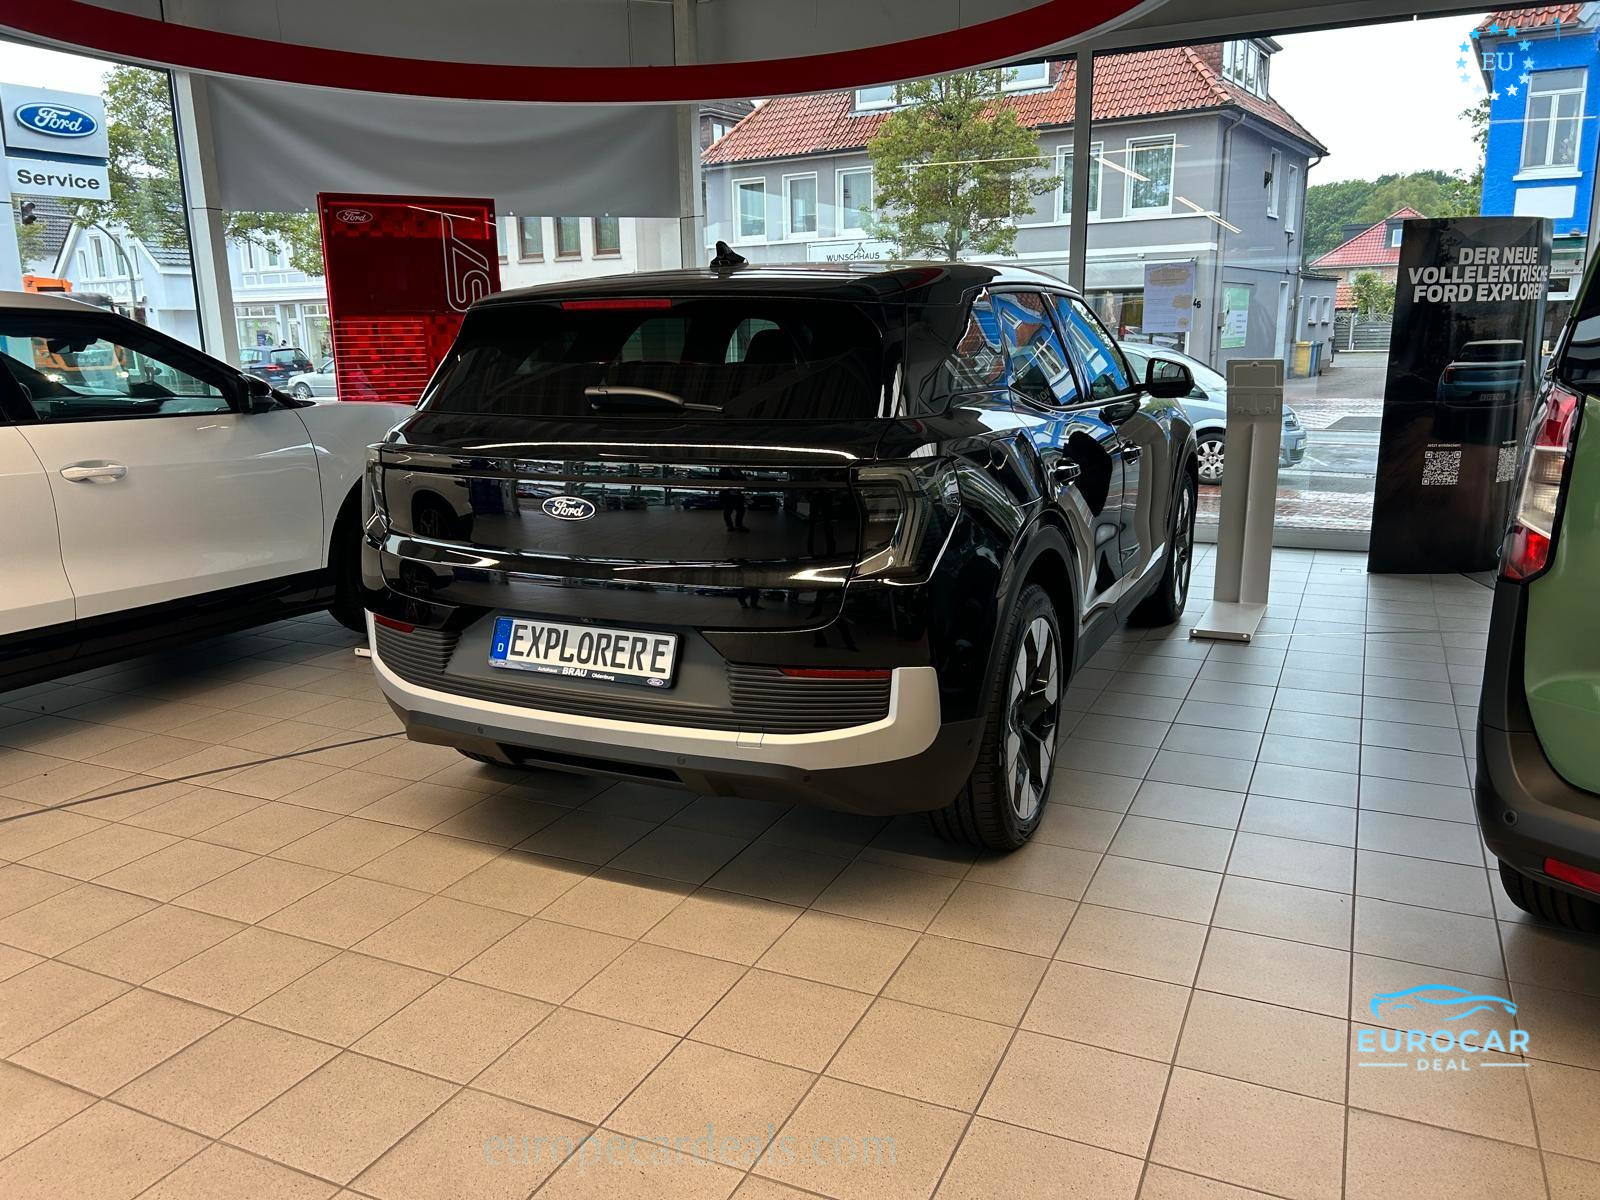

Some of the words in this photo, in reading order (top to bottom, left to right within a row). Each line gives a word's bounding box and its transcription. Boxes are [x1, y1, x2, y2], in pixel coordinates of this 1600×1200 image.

[34, 107, 82, 131] Ford
[17, 169, 100, 190] Service
[343, 210, 367, 222] Ford
[826, 252, 880, 262] WUNSCHHAUS
[1459, 247, 1499, 265] DER
[1502, 246, 1539, 264] NEUE
[1408, 265, 1549, 285] VOLLELEKTRISCHE
[1413, 284, 1473, 303] FORD
[1476, 283, 1543, 302] EXPLORER
[552, 500, 584, 516] Ford
[497, 643, 504, 652] D
[562, 667, 588, 677] BRAU
